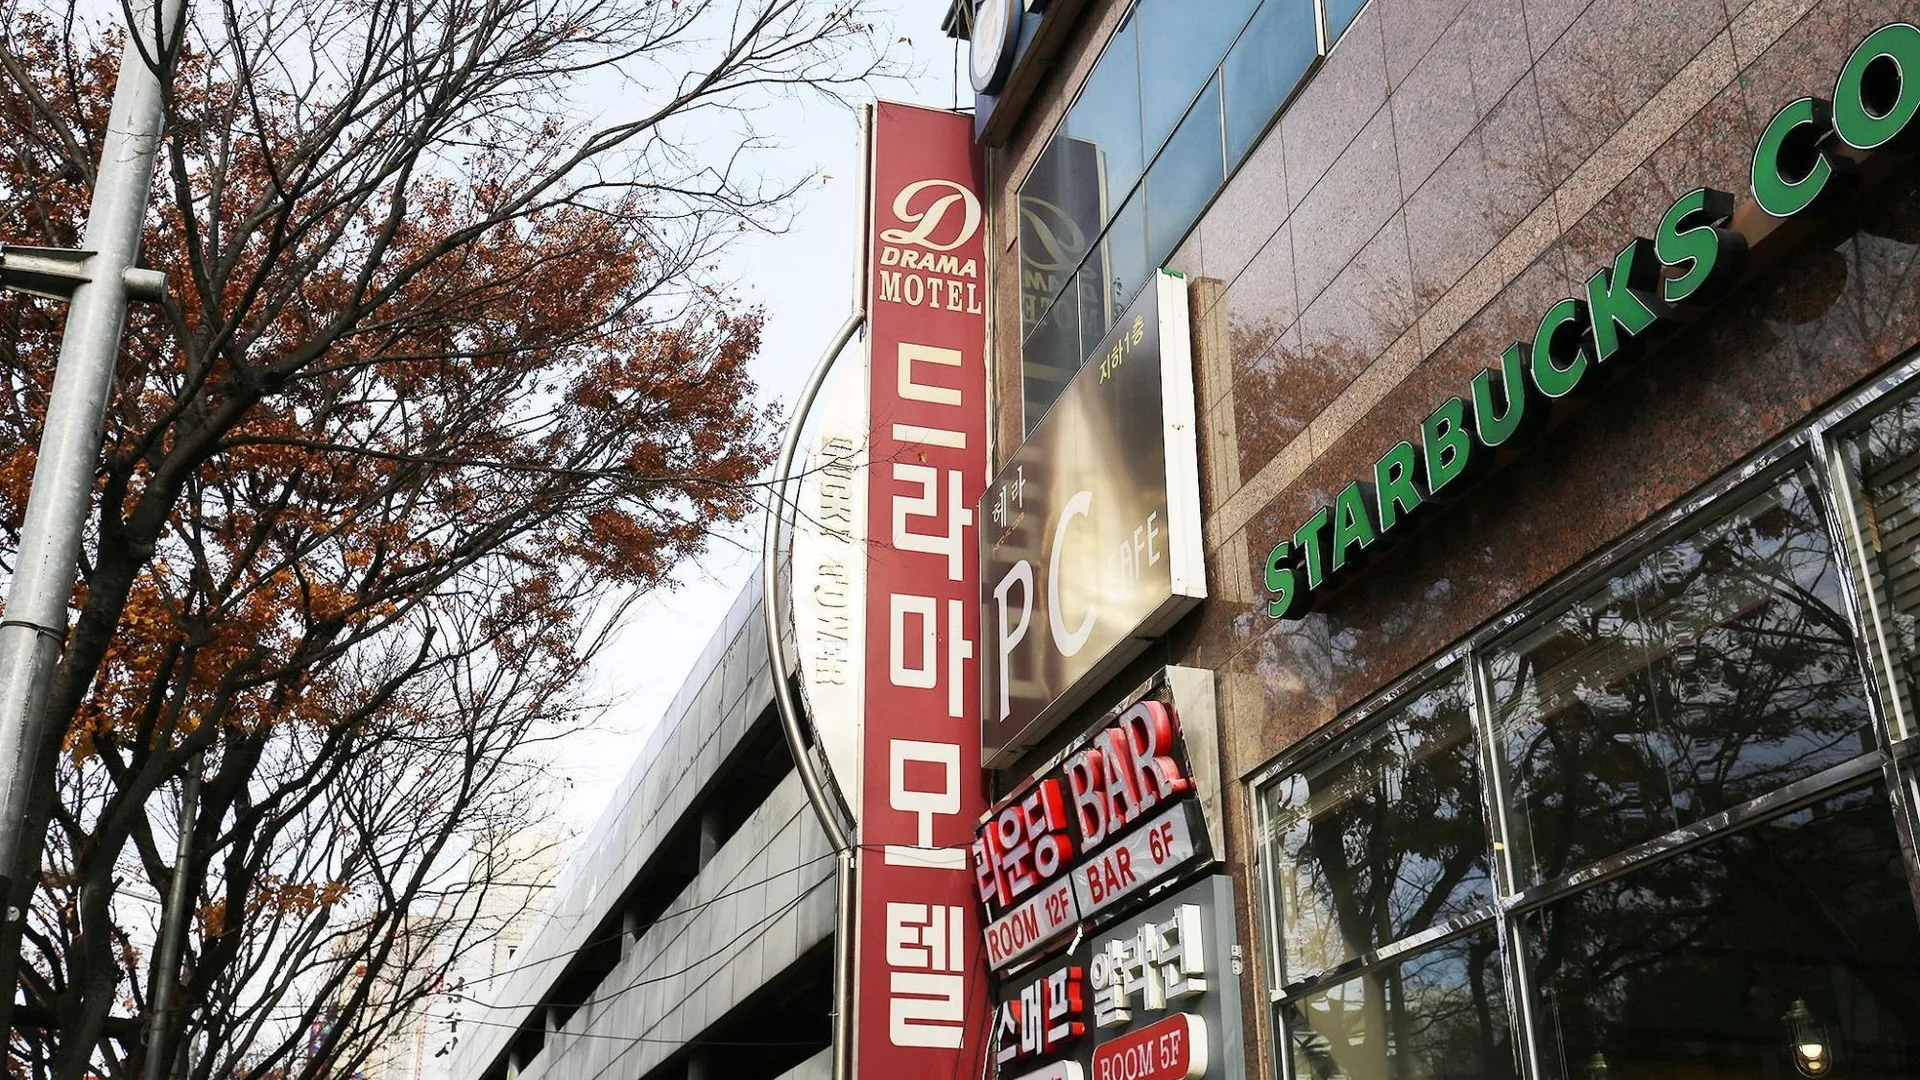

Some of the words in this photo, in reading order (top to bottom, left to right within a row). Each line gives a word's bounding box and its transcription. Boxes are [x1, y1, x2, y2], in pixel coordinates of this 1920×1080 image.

[879, 270, 981, 315] MOTEL
[880, 246, 977, 279] DRAMA
[1099, 314, 1145, 385] 지하1층
[1264, 188, 1718, 619] STARBUCKS
[1751, 22, 1920, 218] CO
[991, 464, 1027, 528] 헤라
[993, 490, 1097, 724] PC
[884, 342, 973, 1049] 드라마모텔
[972, 779, 1068, 908] 라운딩
[1064, 700, 1182, 854] BAR
[1086, 845, 1137, 905] BAR
[1149, 820, 1174, 866] 6F
[988, 903, 1040, 962] ROOM
[1045, 886, 1070, 928] 12F
[1090, 903, 1204, 1028] 알라딘
[997, 966, 1072, 1065] 스머프
[1100, 1040, 1155, 1080] ROOM
[1160, 1028, 1182, 1070] 5F
